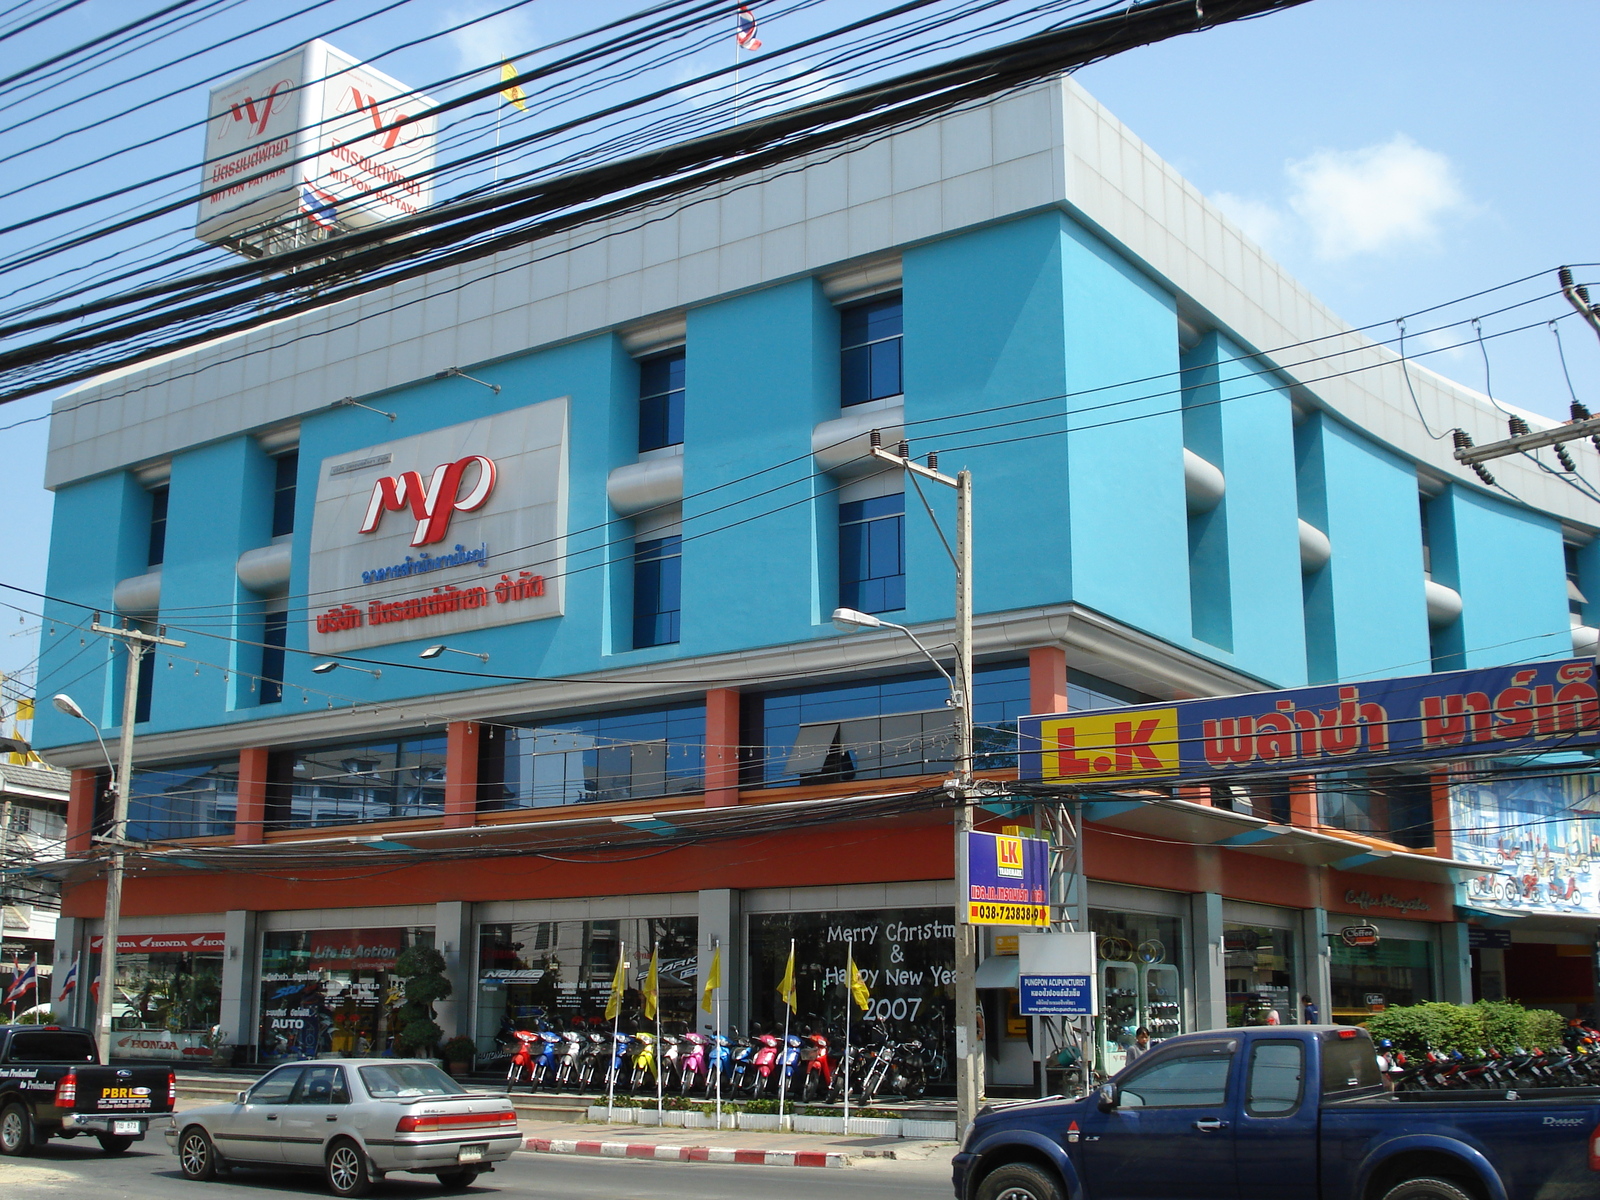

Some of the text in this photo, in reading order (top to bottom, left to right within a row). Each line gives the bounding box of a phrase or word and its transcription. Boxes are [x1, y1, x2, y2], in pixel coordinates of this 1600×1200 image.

[329, 167, 419, 215] MITYON PATTAYA
[1000, 840, 1019, 864] LK
[979, 905, 1039, 921] 038-723838-9
[826, 920, 956, 945] Merry Christm
[1346, 928, 1373, 938] Coffee
[151, 939, 188, 947] HONDA
[314, 944, 397, 959] Life is Action
[890, 944, 904, 964] &
[825, 965, 957, 989] Hapy New Yea
[1024, 978, 1087, 986] PUNGPON ACUPUNCTURIST
[862, 997, 923, 1022] 2007
[271, 1019, 305, 1029] AUTO
